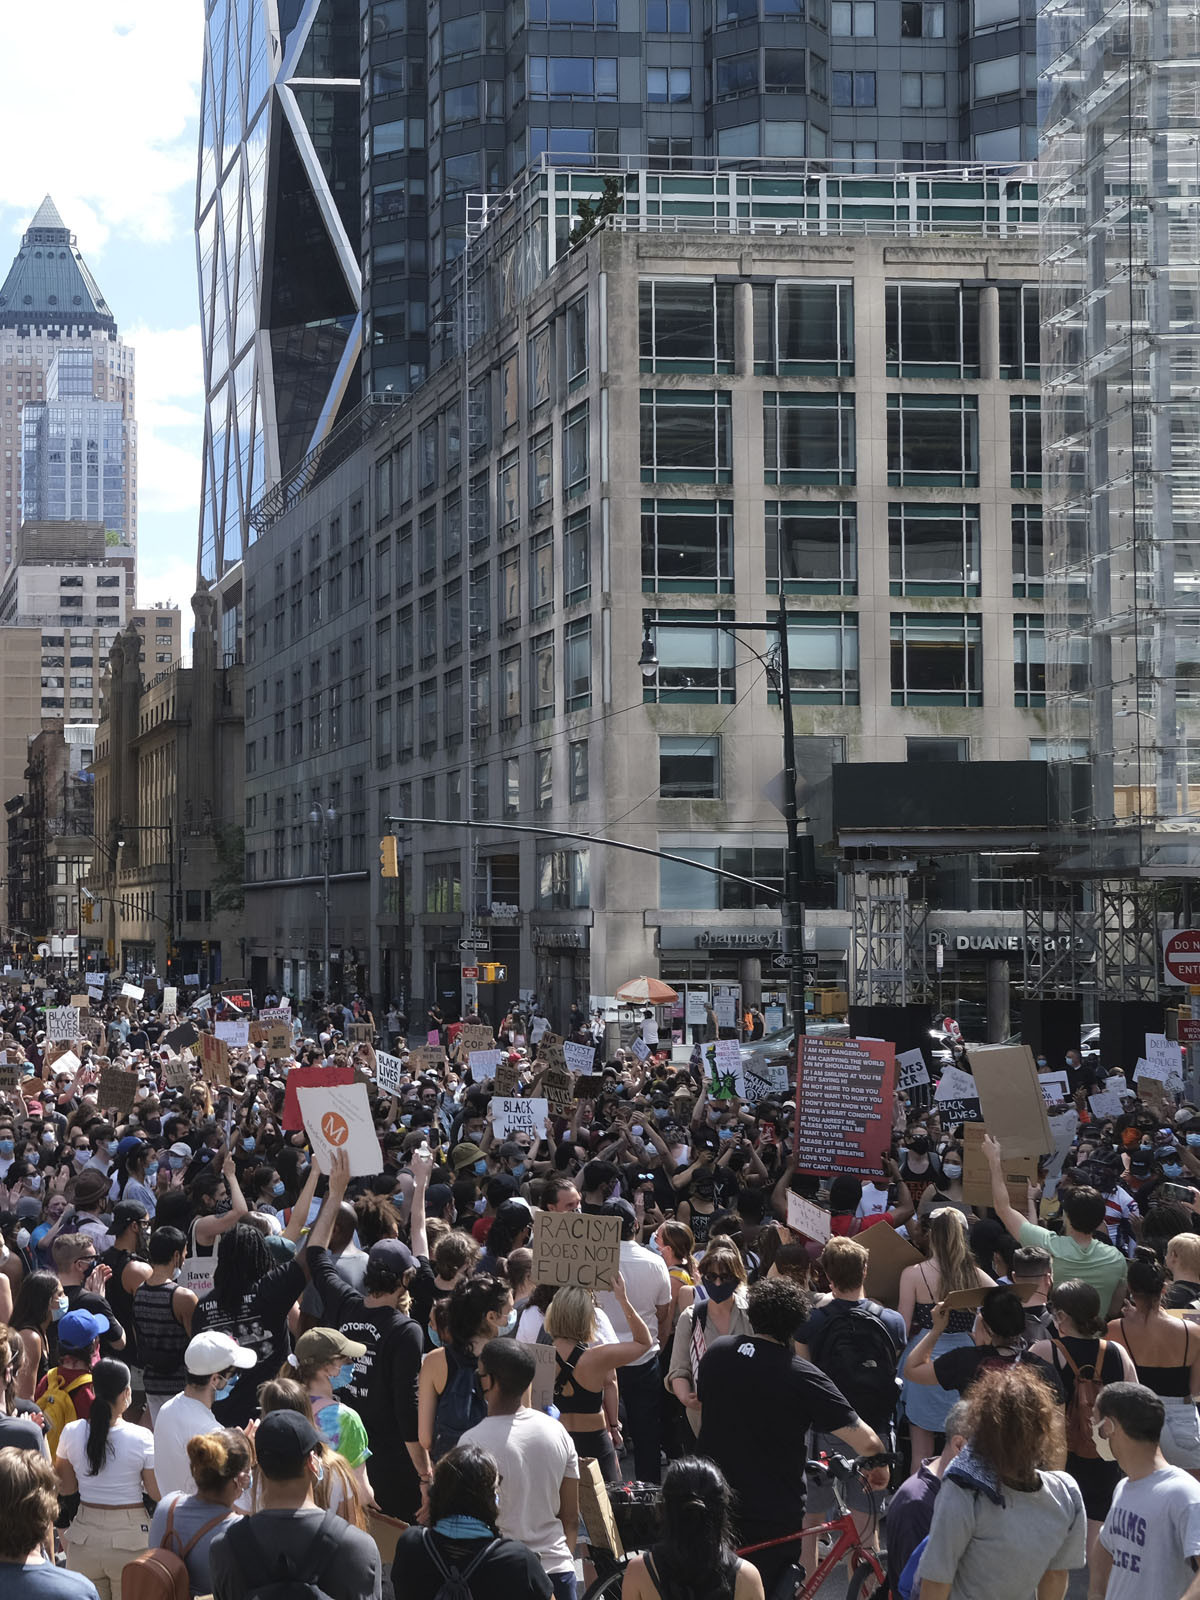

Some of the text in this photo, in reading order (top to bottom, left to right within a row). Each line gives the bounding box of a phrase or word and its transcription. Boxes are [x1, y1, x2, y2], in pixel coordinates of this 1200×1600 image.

[699, 930, 776, 948] pharmacy
[929, 932, 950, 946] DR
[957, 936, 1019, 950] DUANE
[1175, 941, 1189, 950] DO
[48, 1011, 78, 1020] BLACK
[49, 1020, 78, 1029] LIVES
[50, 1028, 79, 1038] MATTER
[464, 1026, 493, 1036] DEFUND
[565, 1043, 591, 1056] DIVEST
[831, 1049, 870, 1057] DANGEROUS
[378, 1054, 399, 1070] BLACK
[567, 1056, 593, 1067] INVEST
[818, 1056, 849, 1064] CARRYING
[165, 1064, 184, 1075] BLM
[824, 1063, 860, 1071] SHOULDERS
[901, 1061, 923, 1076] VES
[379, 1067, 398, 1083] LIVES
[503, 1101, 534, 1115] BLACK
[939, 1100, 965, 1112] BLACK
[508, 1115, 532, 1125] LIVES
[847, 1111, 881, 1120] CONDITION
[948, 1109, 977, 1120] LIVES
[837, 1150, 864, 1158] BREATHE
[541, 1215, 620, 1243] RACISM
[540, 1242, 618, 1263] DOES NOT
[187, 1271, 210, 1281] Have
[537, 1260, 611, 1287] FUCK
[187, 1281, 212, 1290] Pride
